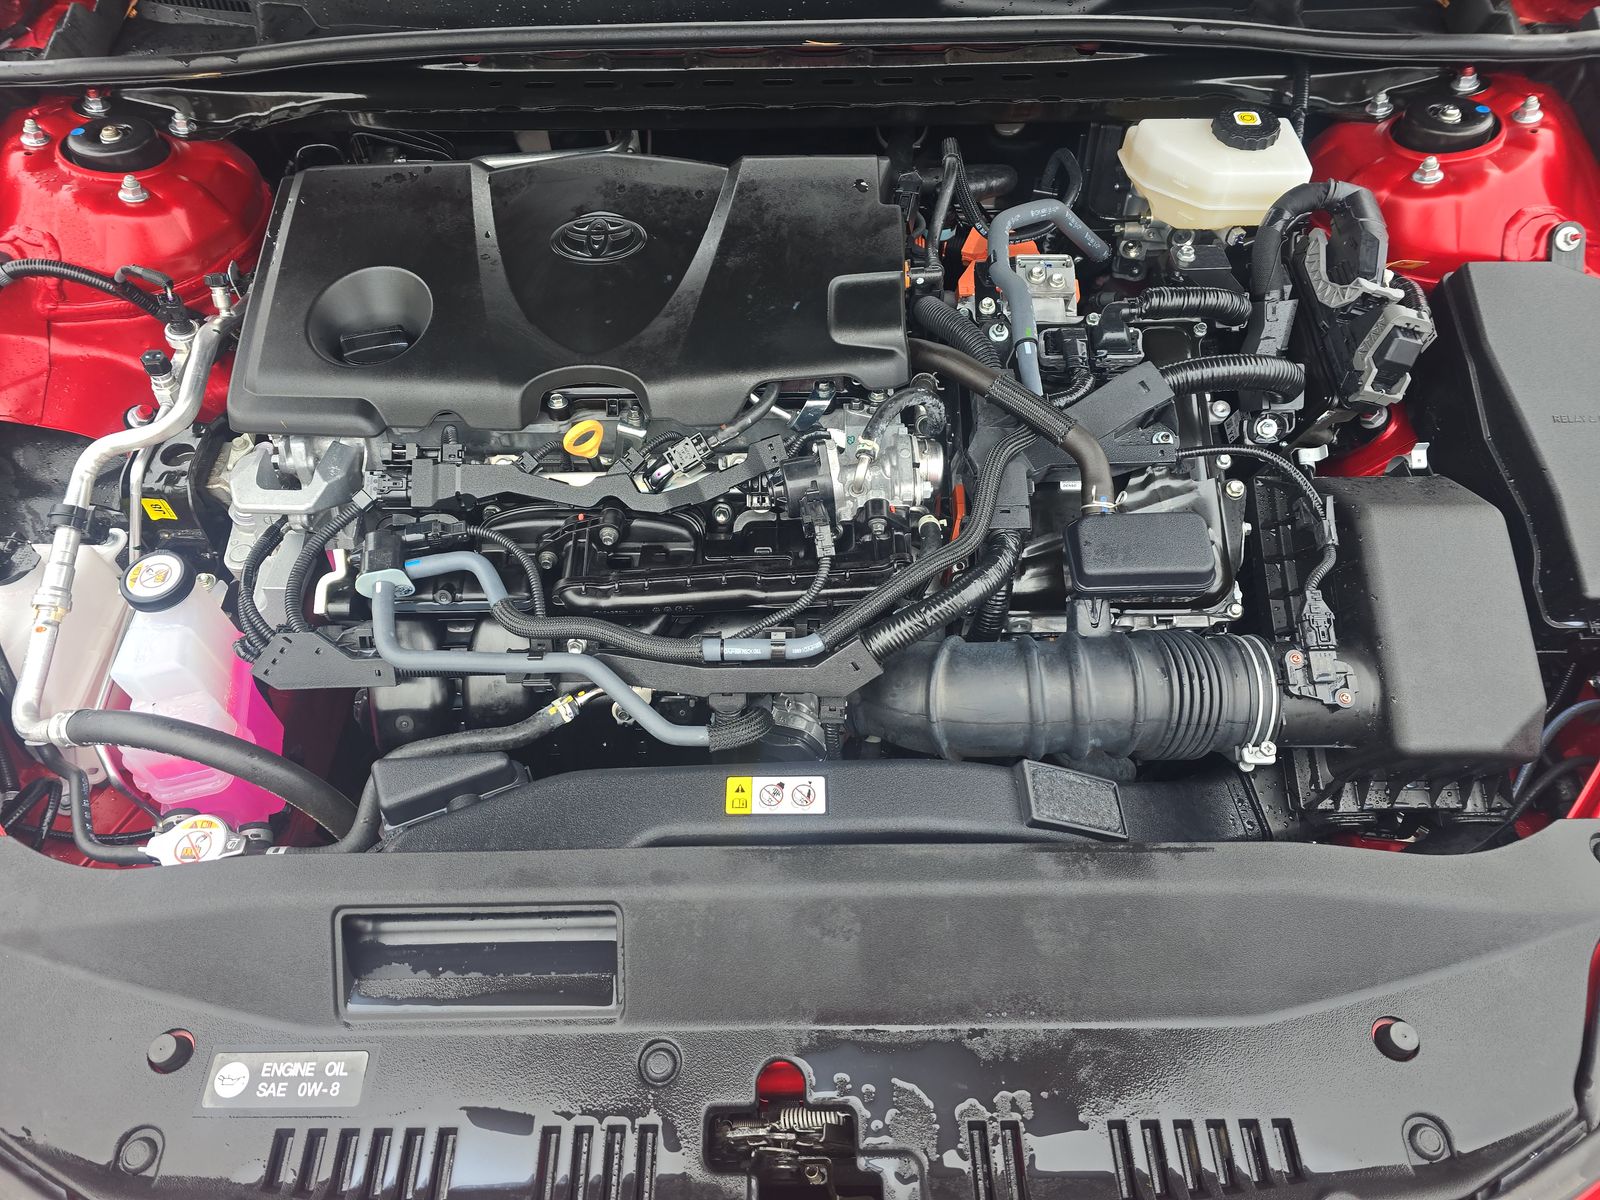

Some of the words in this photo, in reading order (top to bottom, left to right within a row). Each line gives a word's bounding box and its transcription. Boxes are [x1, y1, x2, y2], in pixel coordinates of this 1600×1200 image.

[261, 1062, 316, 1077] ENGINE
[325, 1061, 348, 1077] OIL
[256, 1082, 288, 1097] SAE
[297, 1082, 340, 1097] 0W-8
